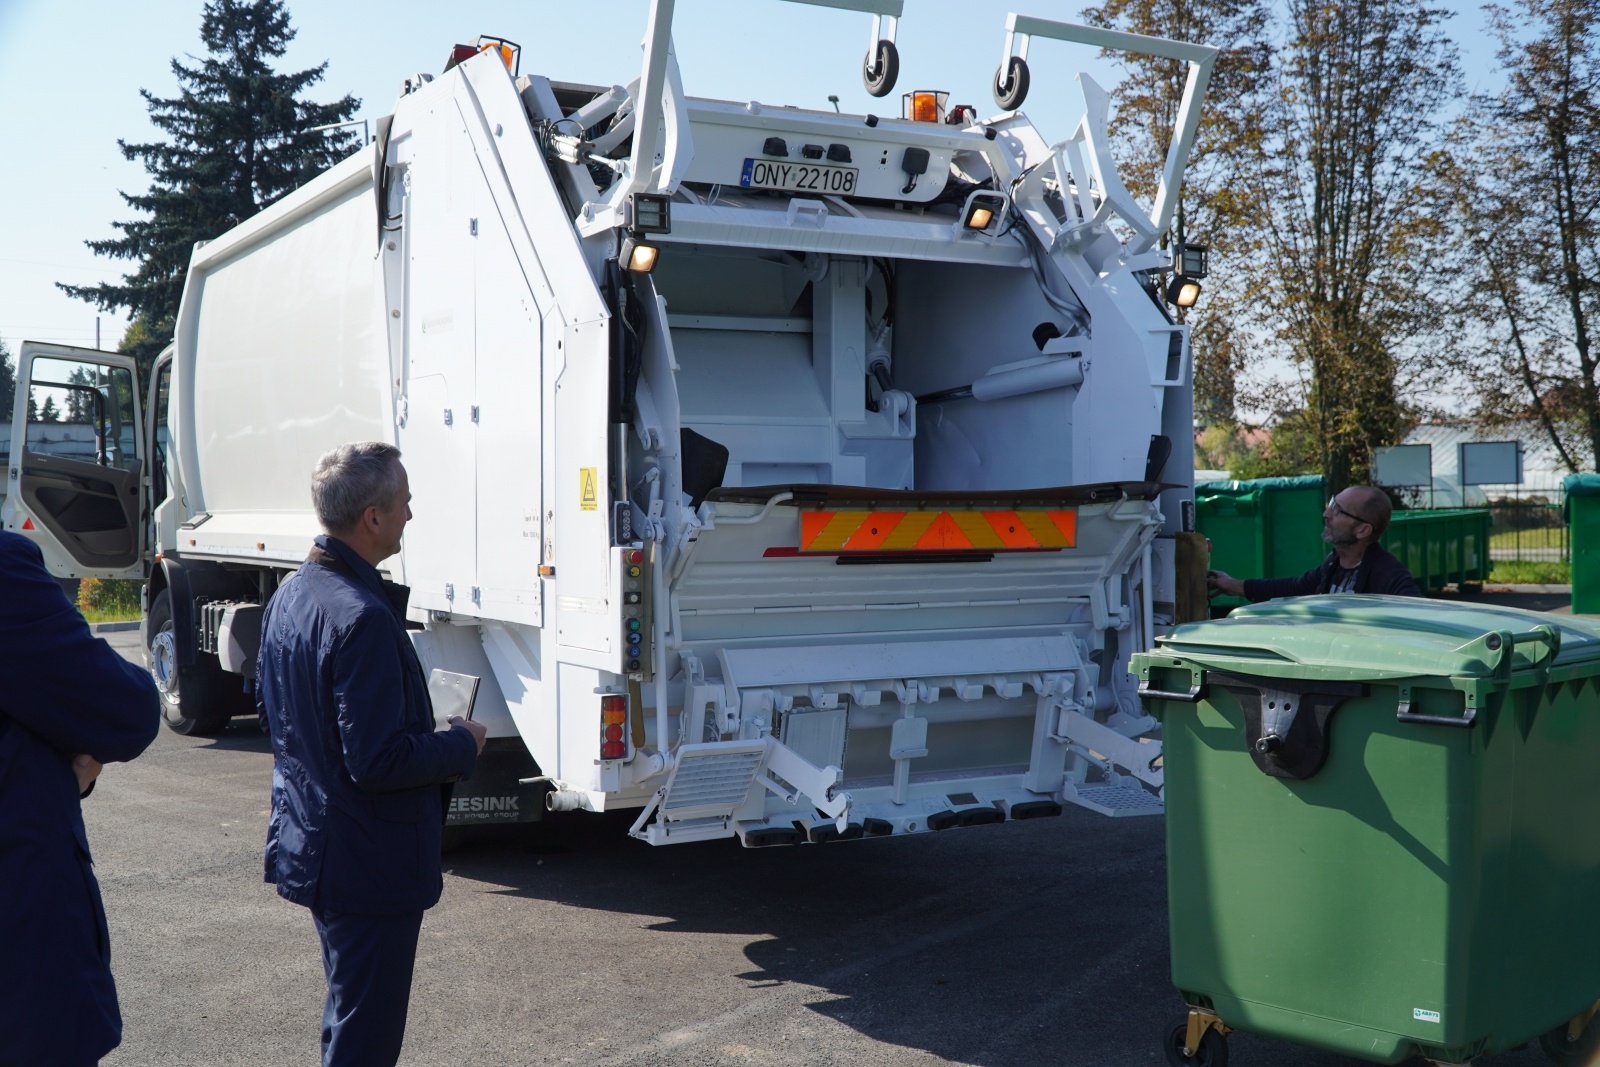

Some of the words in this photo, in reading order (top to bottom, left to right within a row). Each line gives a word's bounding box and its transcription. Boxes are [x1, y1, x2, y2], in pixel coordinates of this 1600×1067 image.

[742, 174, 750, 182] PL
[753, 163, 792, 186] ONY
[796, 167, 854, 192] 22108
